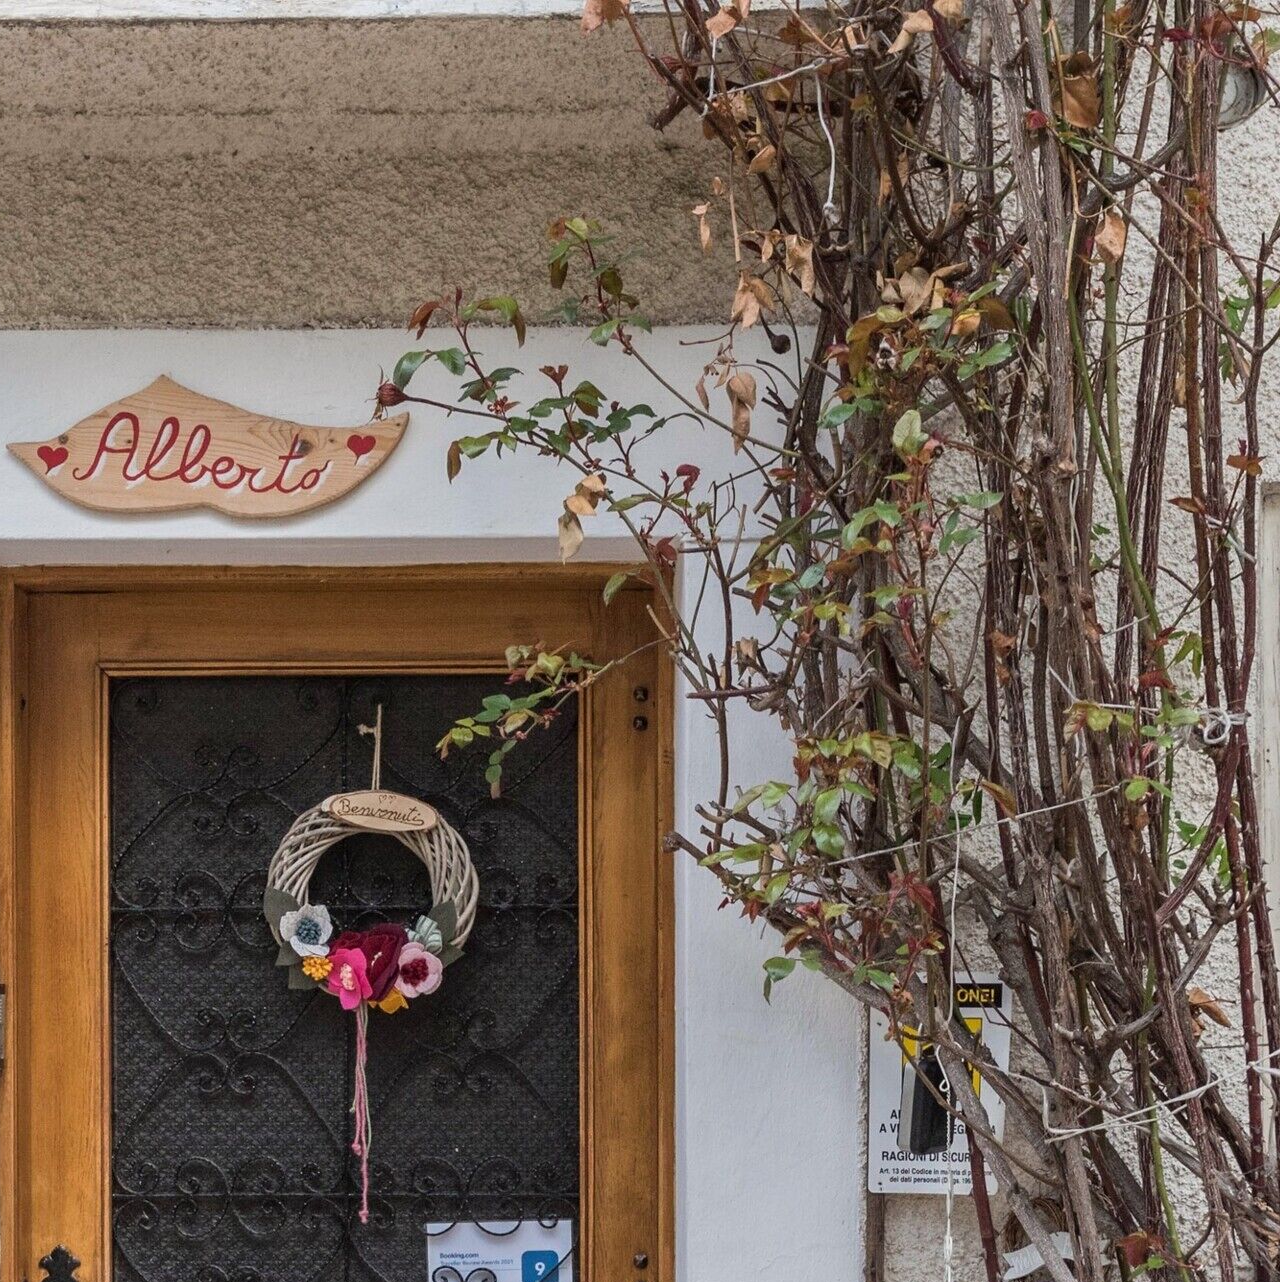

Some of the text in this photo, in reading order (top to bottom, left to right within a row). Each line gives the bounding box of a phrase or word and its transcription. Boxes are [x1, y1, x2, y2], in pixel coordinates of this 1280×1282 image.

[72, 411, 332, 493] Alberto
[337, 798, 424, 826] Benvenuti
[881, 1151, 926, 1161] RAGIONI
[911, 1167, 932, 1175] Codice
[439, 1252, 479, 1260] Booking.com
[534, 1262, 546, 1276] 9
